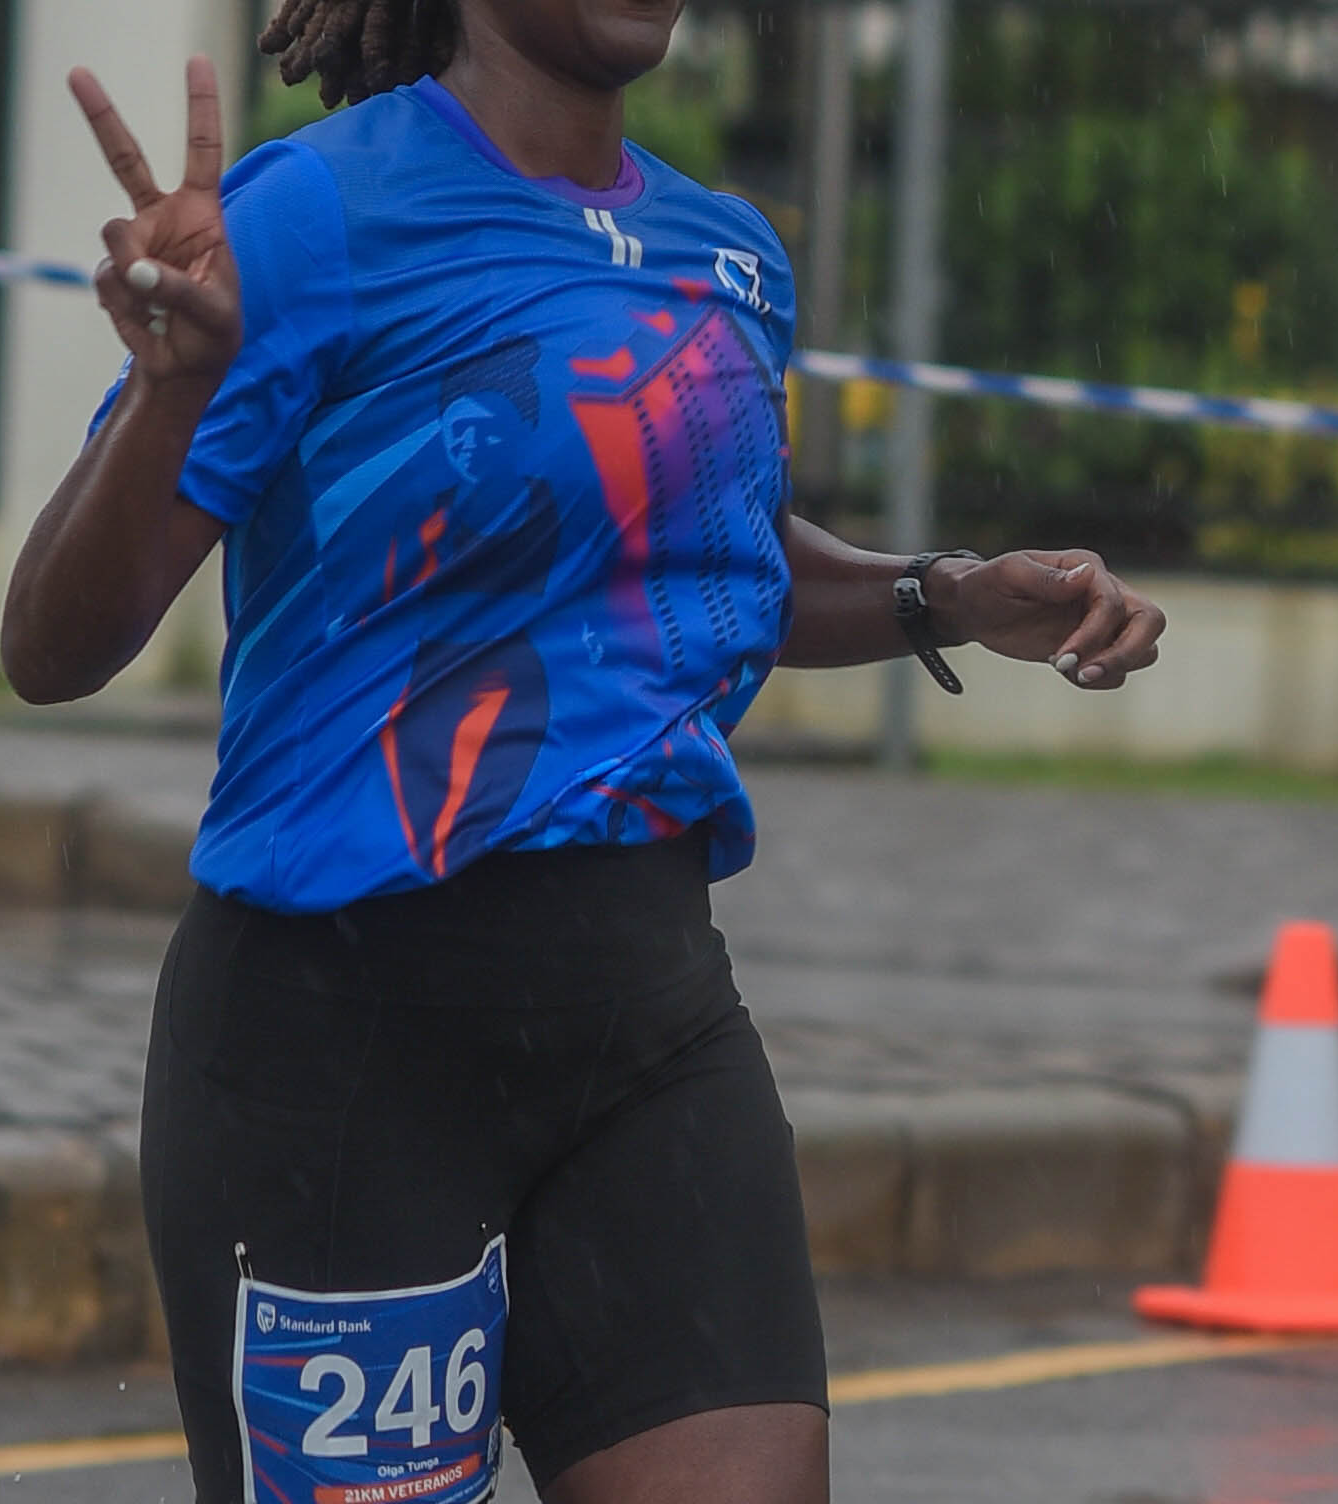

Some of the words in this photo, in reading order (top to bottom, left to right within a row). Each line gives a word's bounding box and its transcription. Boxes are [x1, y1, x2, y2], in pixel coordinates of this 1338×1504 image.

[279, 1314, 335, 1334] Standard
[338, 1318, 372, 1334] Bank
[299, 1327, 486, 1458] 246
[377, 1464, 405, 1479] Olga
[407, 1456, 440, 1474] Tunga
[344, 1488, 386, 1504] 21KM
[387, 1465, 463, 1500] VETERANOS
